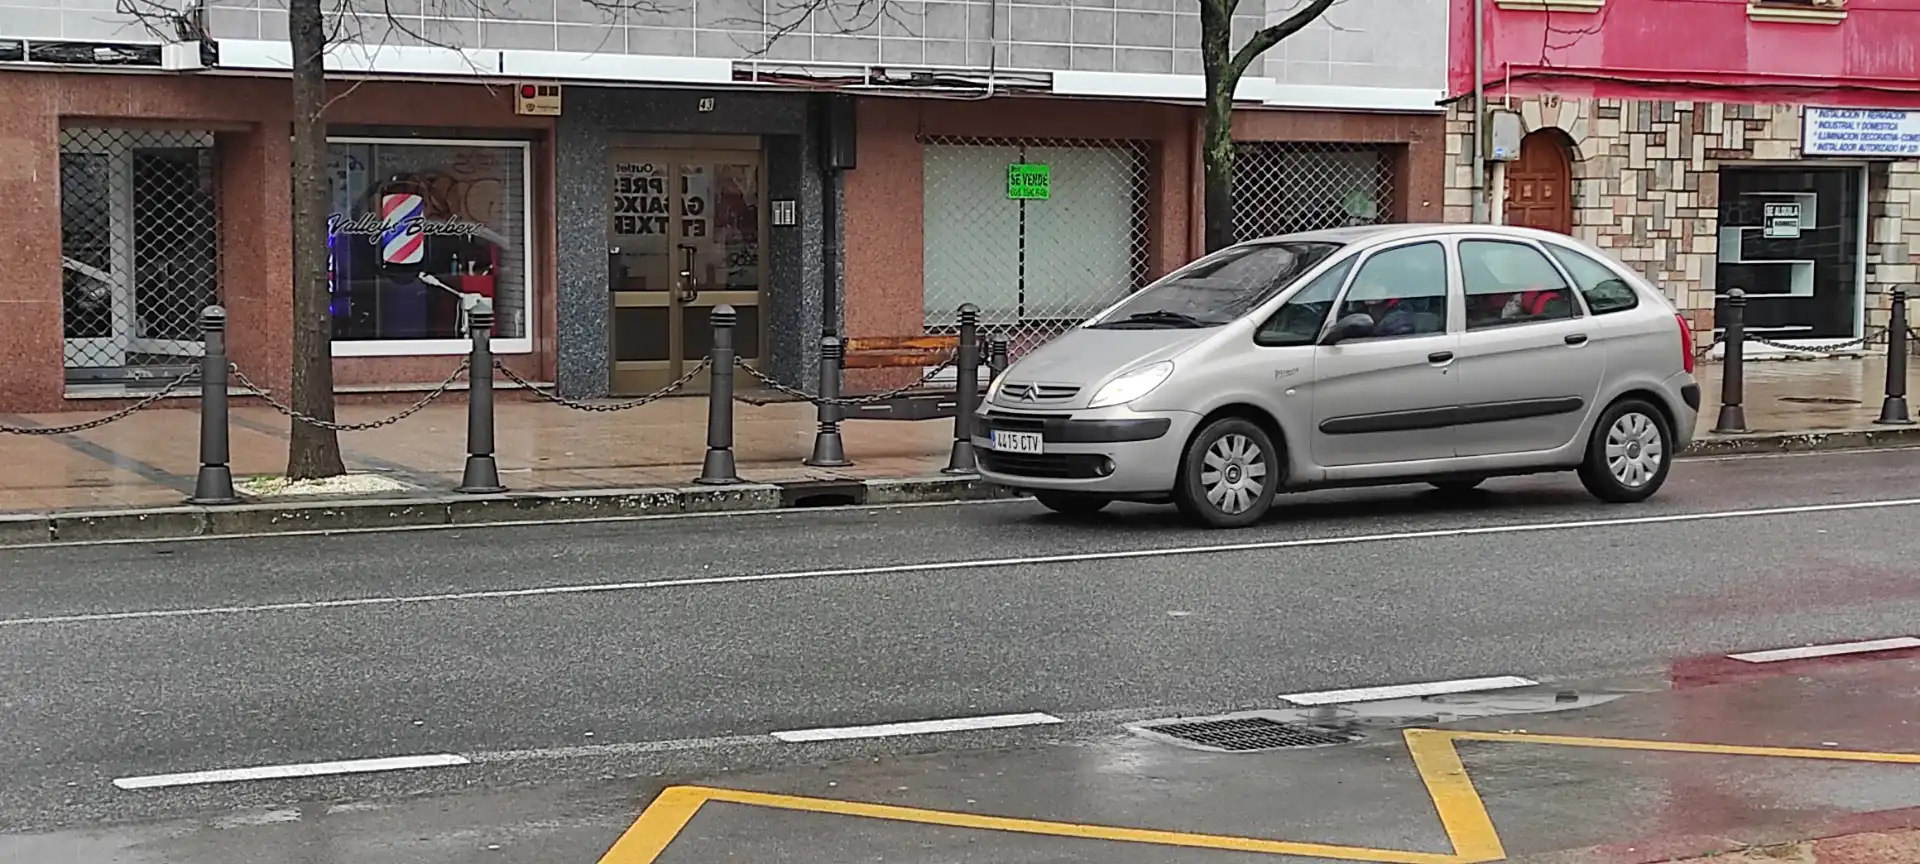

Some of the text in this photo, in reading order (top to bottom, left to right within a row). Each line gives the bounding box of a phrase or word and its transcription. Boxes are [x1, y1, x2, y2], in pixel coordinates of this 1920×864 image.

[1818, 121, 1855, 130] INDUSTRIAL
[1817, 143, 1857, 151] INSTALADOR
[1858, 143, 1899, 152] AUTORIZADO
[1010, 172, 1048, 186] SE VENDE
[1766, 206, 1798, 217] SE ALQUILA
[997, 433, 1038, 451] 4415 CTV
